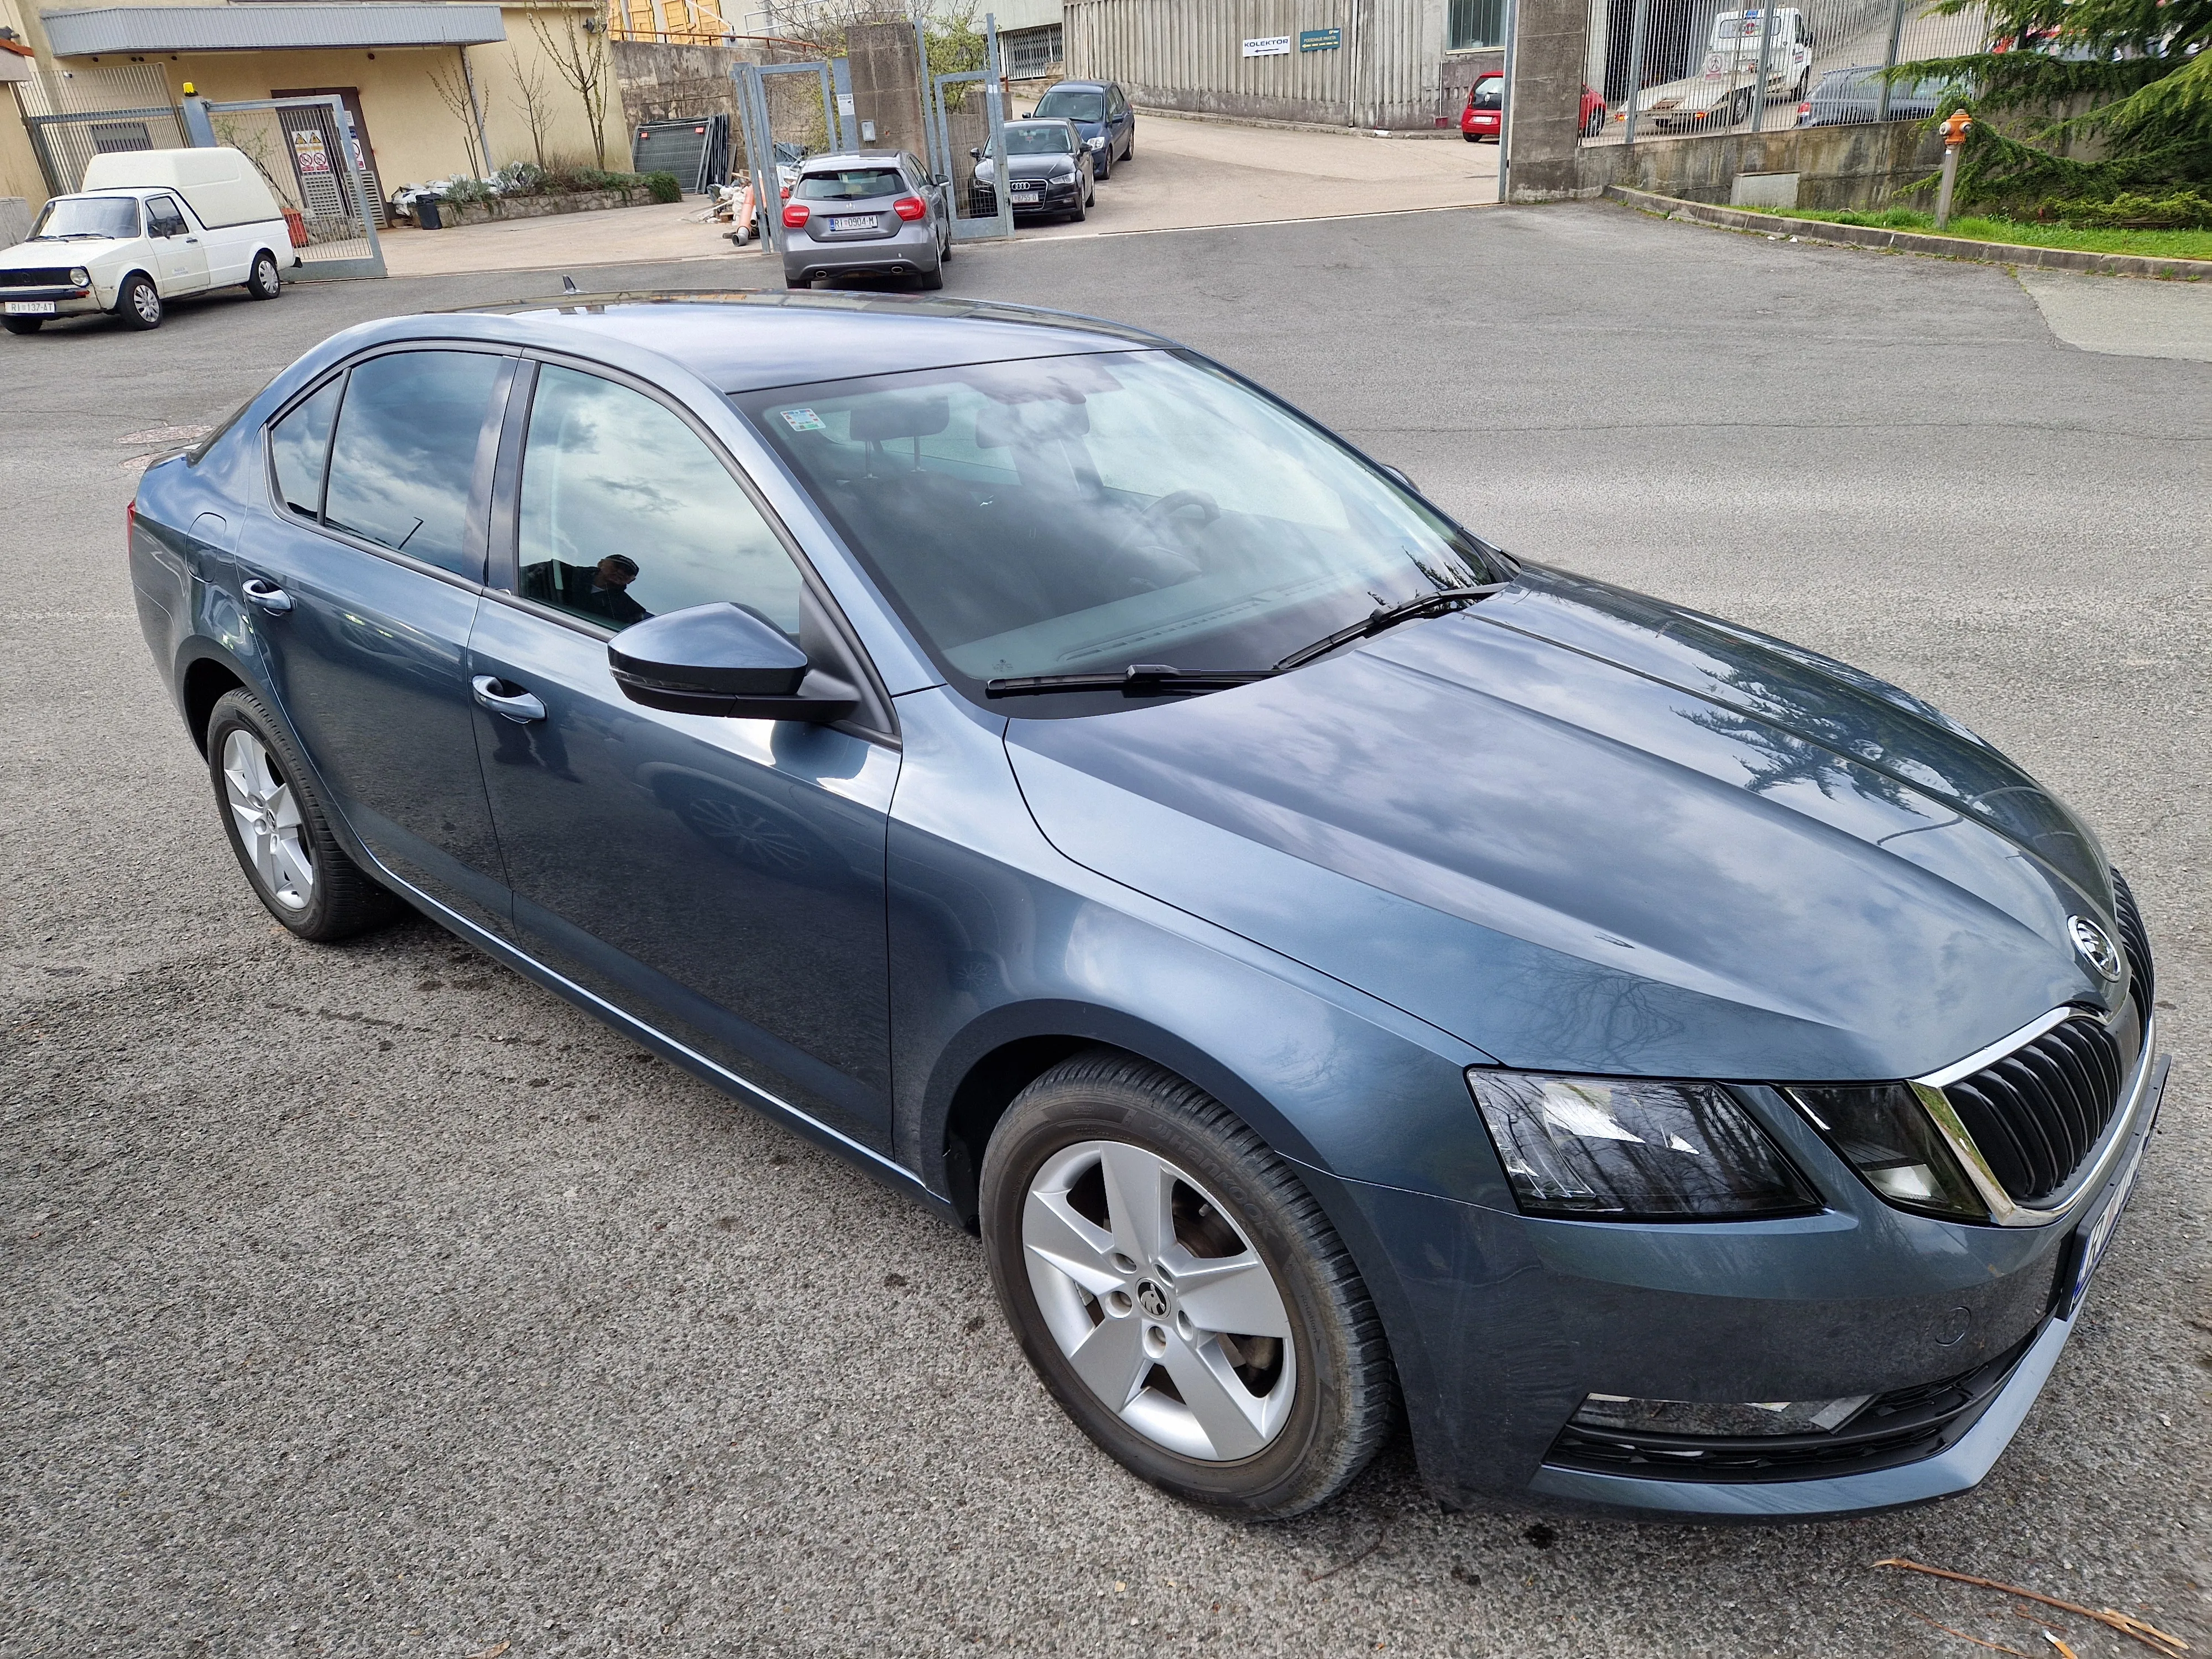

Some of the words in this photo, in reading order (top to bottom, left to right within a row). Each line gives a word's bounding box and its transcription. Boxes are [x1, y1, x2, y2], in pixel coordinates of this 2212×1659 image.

[1244, 39, 1288, 48] KOLEKTOR
[834, 218, 843, 228] RI
[848, 216, 874, 227] 0904-M
[11, 303, 20, 311] RI
[28, 303, 53, 311] 137-AT
[1301, 1293, 1318, 1334] Rotation
